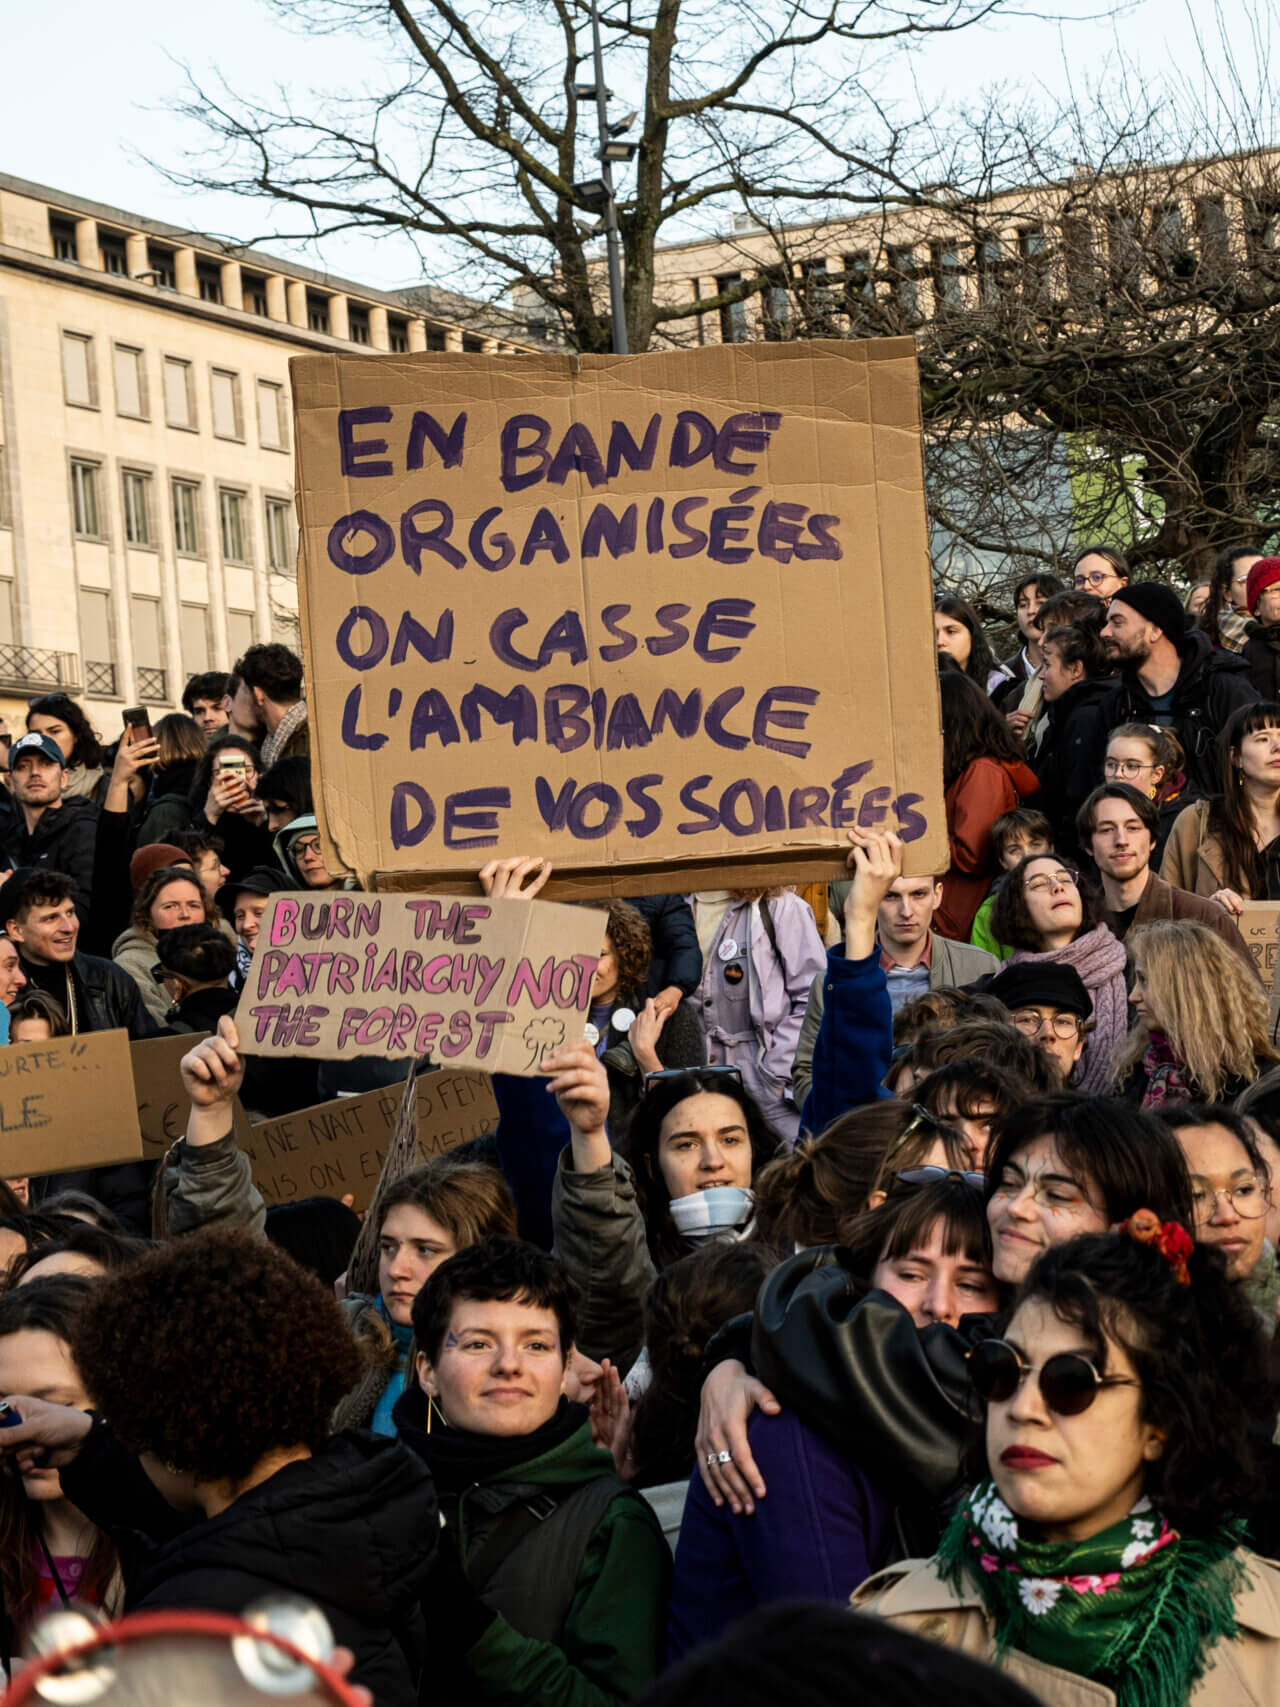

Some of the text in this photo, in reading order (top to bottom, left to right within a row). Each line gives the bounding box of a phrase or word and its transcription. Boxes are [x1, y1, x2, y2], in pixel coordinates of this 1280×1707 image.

[337, 405, 782, 492] EN BANDE
[327, 485, 843, 576] ORGANISÉES
[336, 598, 757, 672] ON CASSE
[341, 683, 822, 759] L'AMBIANCE
[390, 759, 929, 851] DE VOS SOIRÉES
[270, 898, 492, 947] BURN THE
[507, 954, 602, 1012] NOT
[250, 1003, 514, 1059] THE FOREST
[264, 1122, 298, 1158] NE
[308, 1105, 365, 1145] NAIT
[309, 1160, 345, 1190] ON
